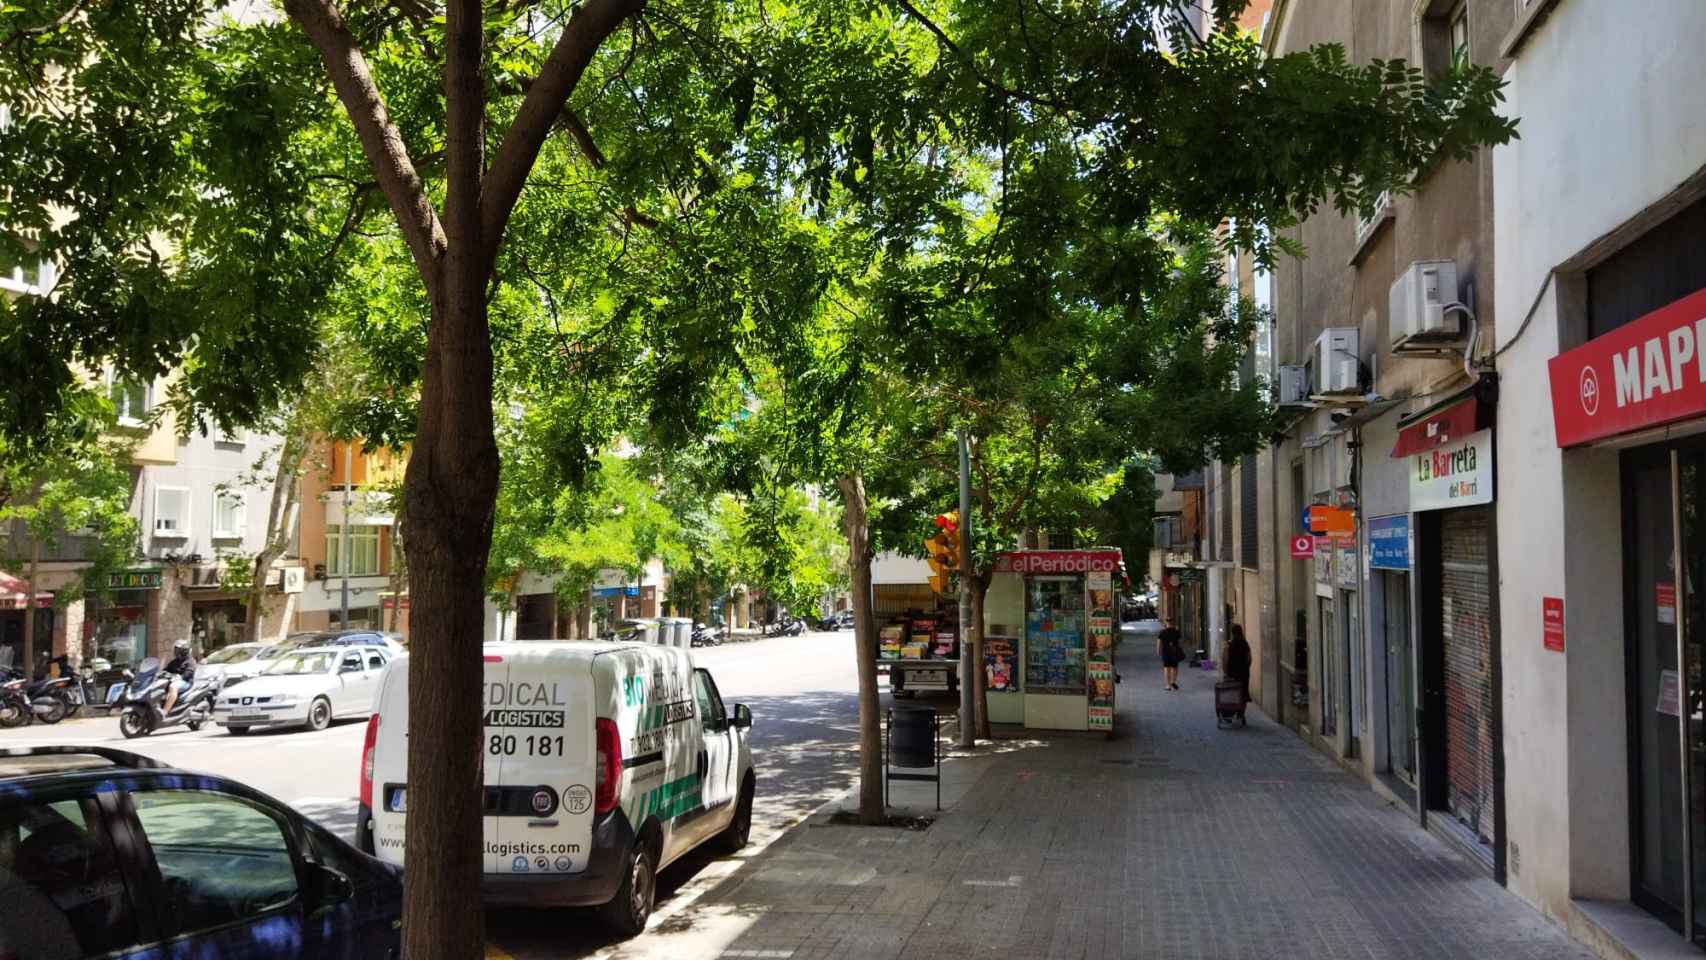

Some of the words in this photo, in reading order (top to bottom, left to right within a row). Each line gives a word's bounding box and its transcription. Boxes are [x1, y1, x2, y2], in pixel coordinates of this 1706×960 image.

[1612, 317, 1706, 409] MAP
[1418, 455, 1431, 482] La
[1432, 441, 1477, 479] Barreta
[1449, 480, 1460, 498] del
[1013, 556, 1029, 572] el
[1030, 555, 1115, 573] Periódico
[483, 682, 567, 706] DICAL
[490, 711, 562, 727] LOGISTICS
[489, 734, 517, 756] 80
[526, 735, 564, 757] 181
